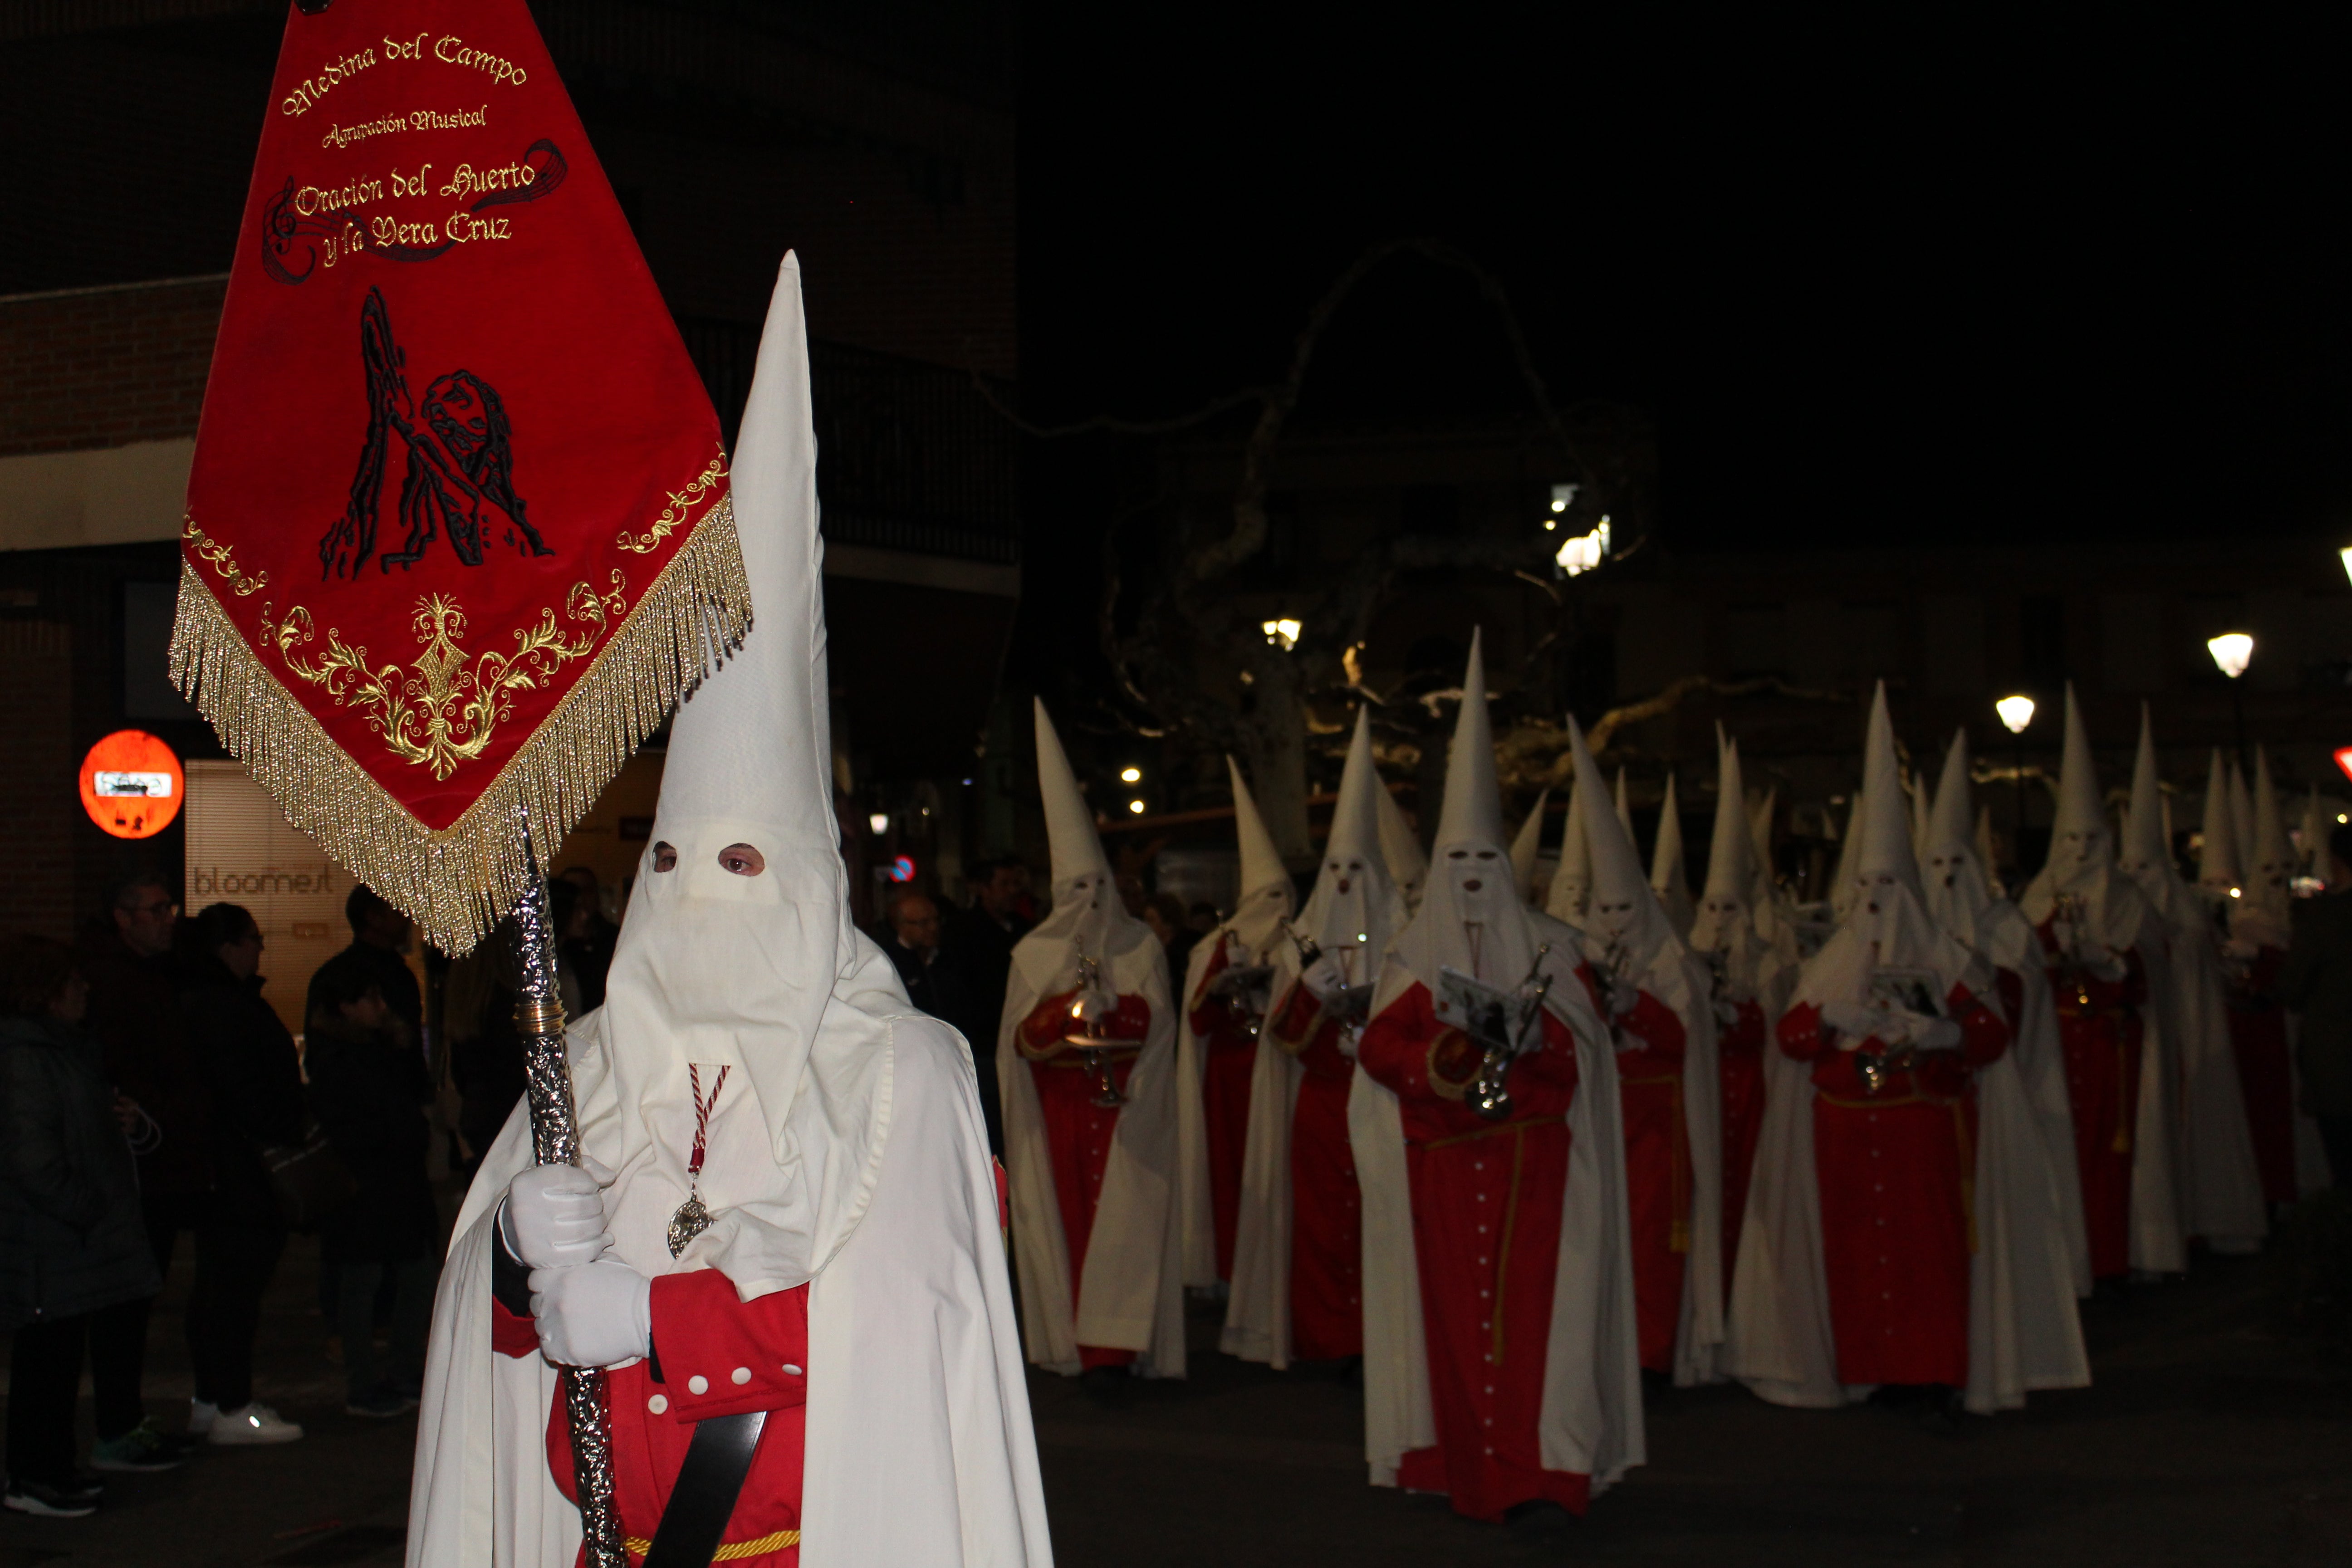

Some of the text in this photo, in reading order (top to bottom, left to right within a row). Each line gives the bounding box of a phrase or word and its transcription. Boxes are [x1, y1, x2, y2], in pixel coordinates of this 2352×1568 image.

[282, 32, 527, 117] Medina del Campo
[322, 104, 487, 148] Agrupación Musical
[295, 161, 535, 216] Oración del Huerto
[323, 210, 512, 268] y la Vera Cruz
